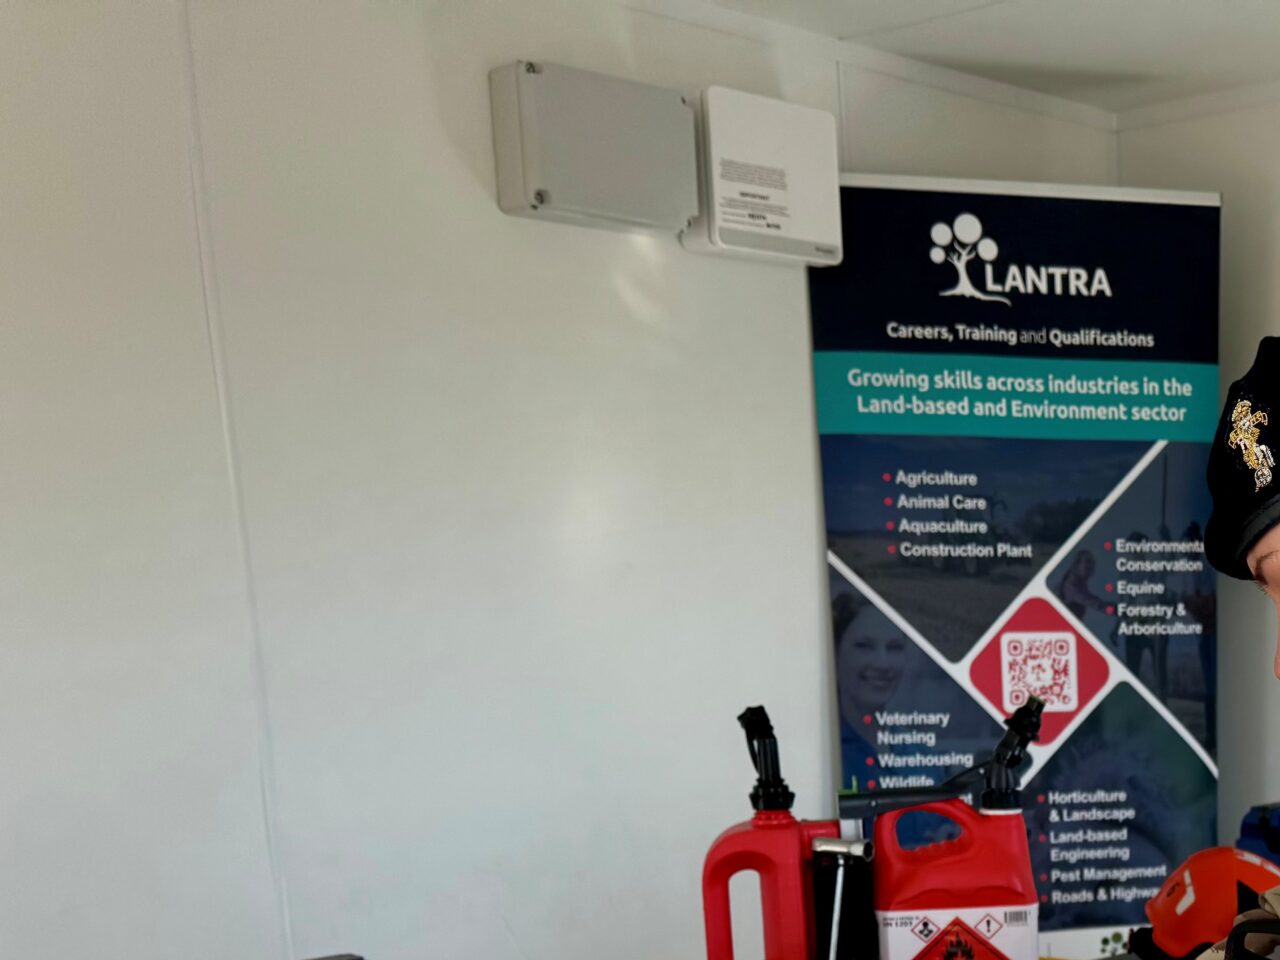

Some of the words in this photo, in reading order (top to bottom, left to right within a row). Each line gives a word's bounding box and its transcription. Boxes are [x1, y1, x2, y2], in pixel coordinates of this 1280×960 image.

[985, 263, 1112, 297] LANTRA
[886, 322, 953, 342] Careers,
[955, 324, 1017, 345] Training
[1020, 329, 1047, 344] and
[1049, 329, 1154, 347] Qualifications
[848, 368, 929, 391] Growing
[933, 371, 982, 390] skills
[987, 377, 1044, 392] across
[1048, 374, 1139, 395] industries
[1143, 378, 1159, 395] in
[1163, 378, 1192, 396] the
[857, 395, 970, 415] Land-based
[973, 398, 1007, 417] and
[1011, 400, 1127, 420] Environment
[1131, 405, 1187, 421] sector
[896, 469, 977, 488] Agriculture
[897, 494, 949, 509] Animal
[952, 495, 987, 510] Care
[899, 518, 987, 536] Aquaculture
[900, 541, 994, 557] Construction
[997, 543, 1033, 558] Plant
[1116, 539, 1205, 553] Environmenta
[1116, 557, 1203, 572] Conservation
[1117, 580, 1165, 597] Equine
[1117, 603, 1173, 619] Forestry
[1176, 603, 1186, 617] &
[1118, 621, 1203, 636] Arboriculture
[875, 710, 950, 728] Veterinary
[877, 730, 936, 747] Nursing
[878, 752, 974, 768] Warehousing
[879, 775, 934, 789] Wildlife
[1048, 789, 1127, 805] Horticulture
[1049, 809, 1059, 823] &
[1063, 808, 1136, 822] Landscape
[1050, 827, 1128, 844] Land-based
[1051, 846, 1130, 863] Engineering
[1051, 869, 1081, 883] Pest
[1083, 864, 1167, 881] Management
[1052, 890, 1093, 904] Roads
[1097, 888, 1107, 901] &
[1110, 886, 1160, 902] Highwa
